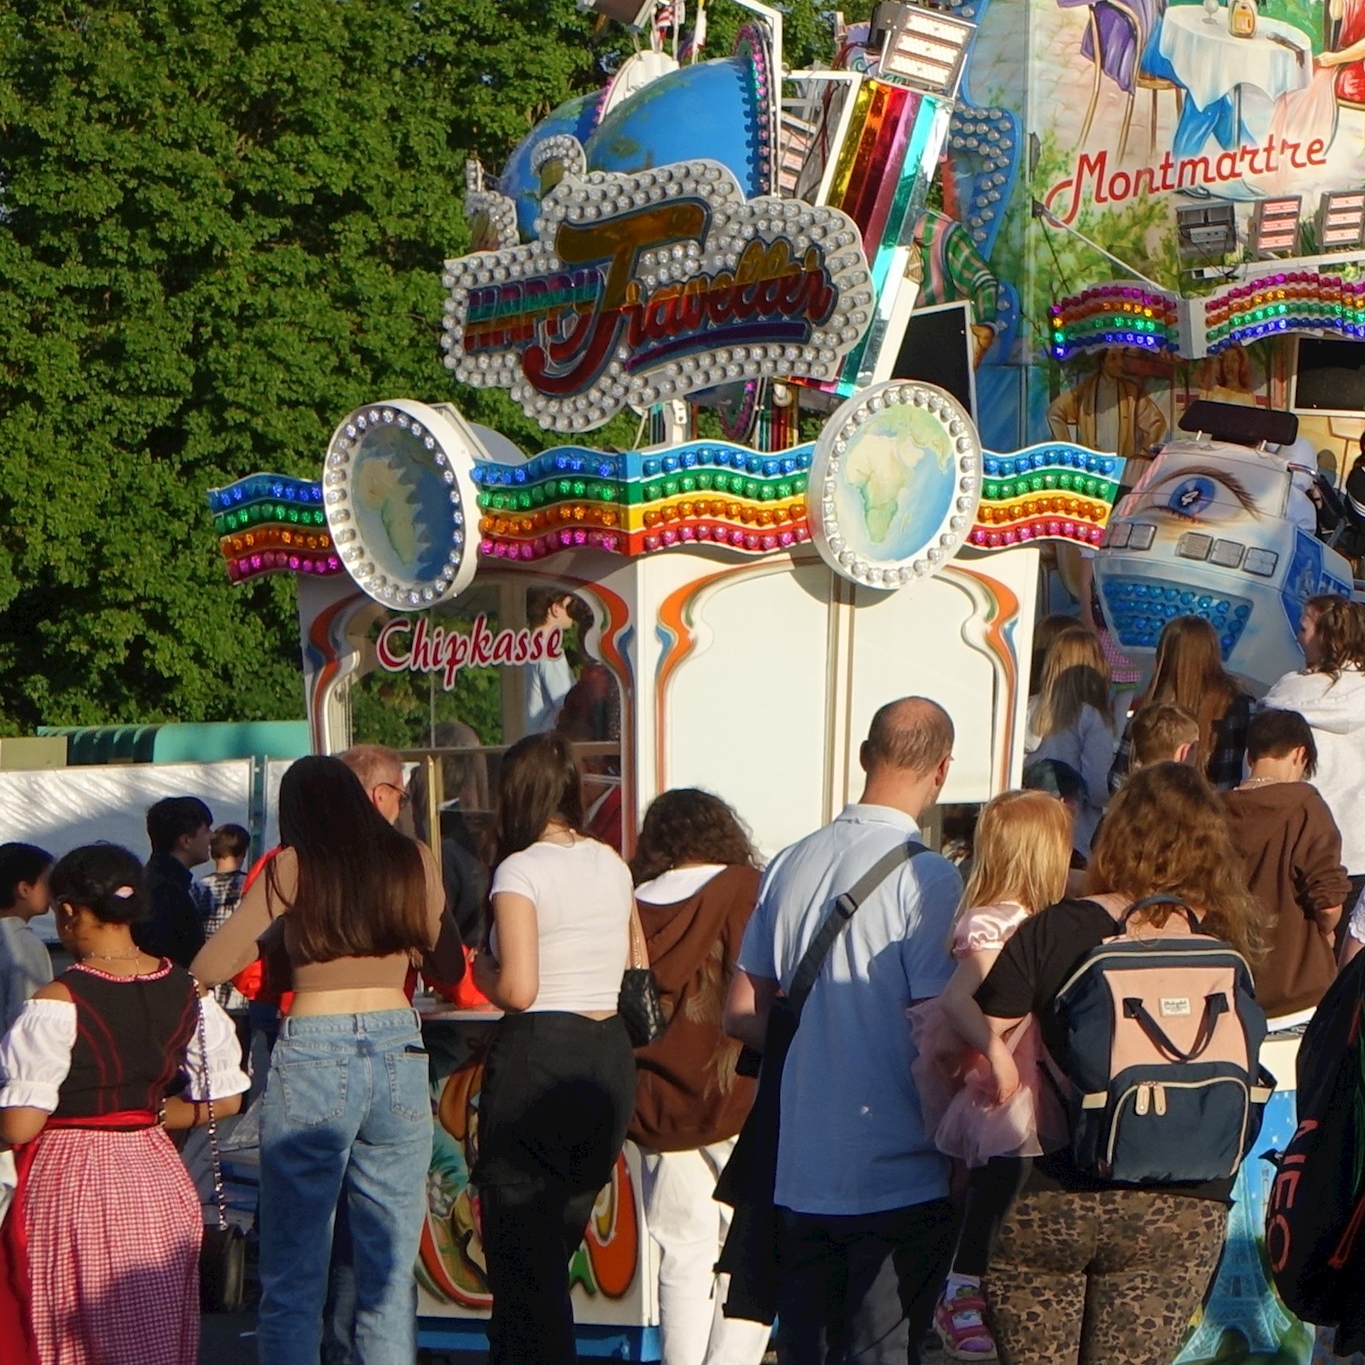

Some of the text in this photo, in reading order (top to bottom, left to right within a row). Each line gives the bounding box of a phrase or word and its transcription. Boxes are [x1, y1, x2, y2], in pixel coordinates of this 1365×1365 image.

[1045, 134, 1328, 228] Montmartre
[522, 196, 838, 397] Traveller
[377, 613, 564, 690] Chipkasse
